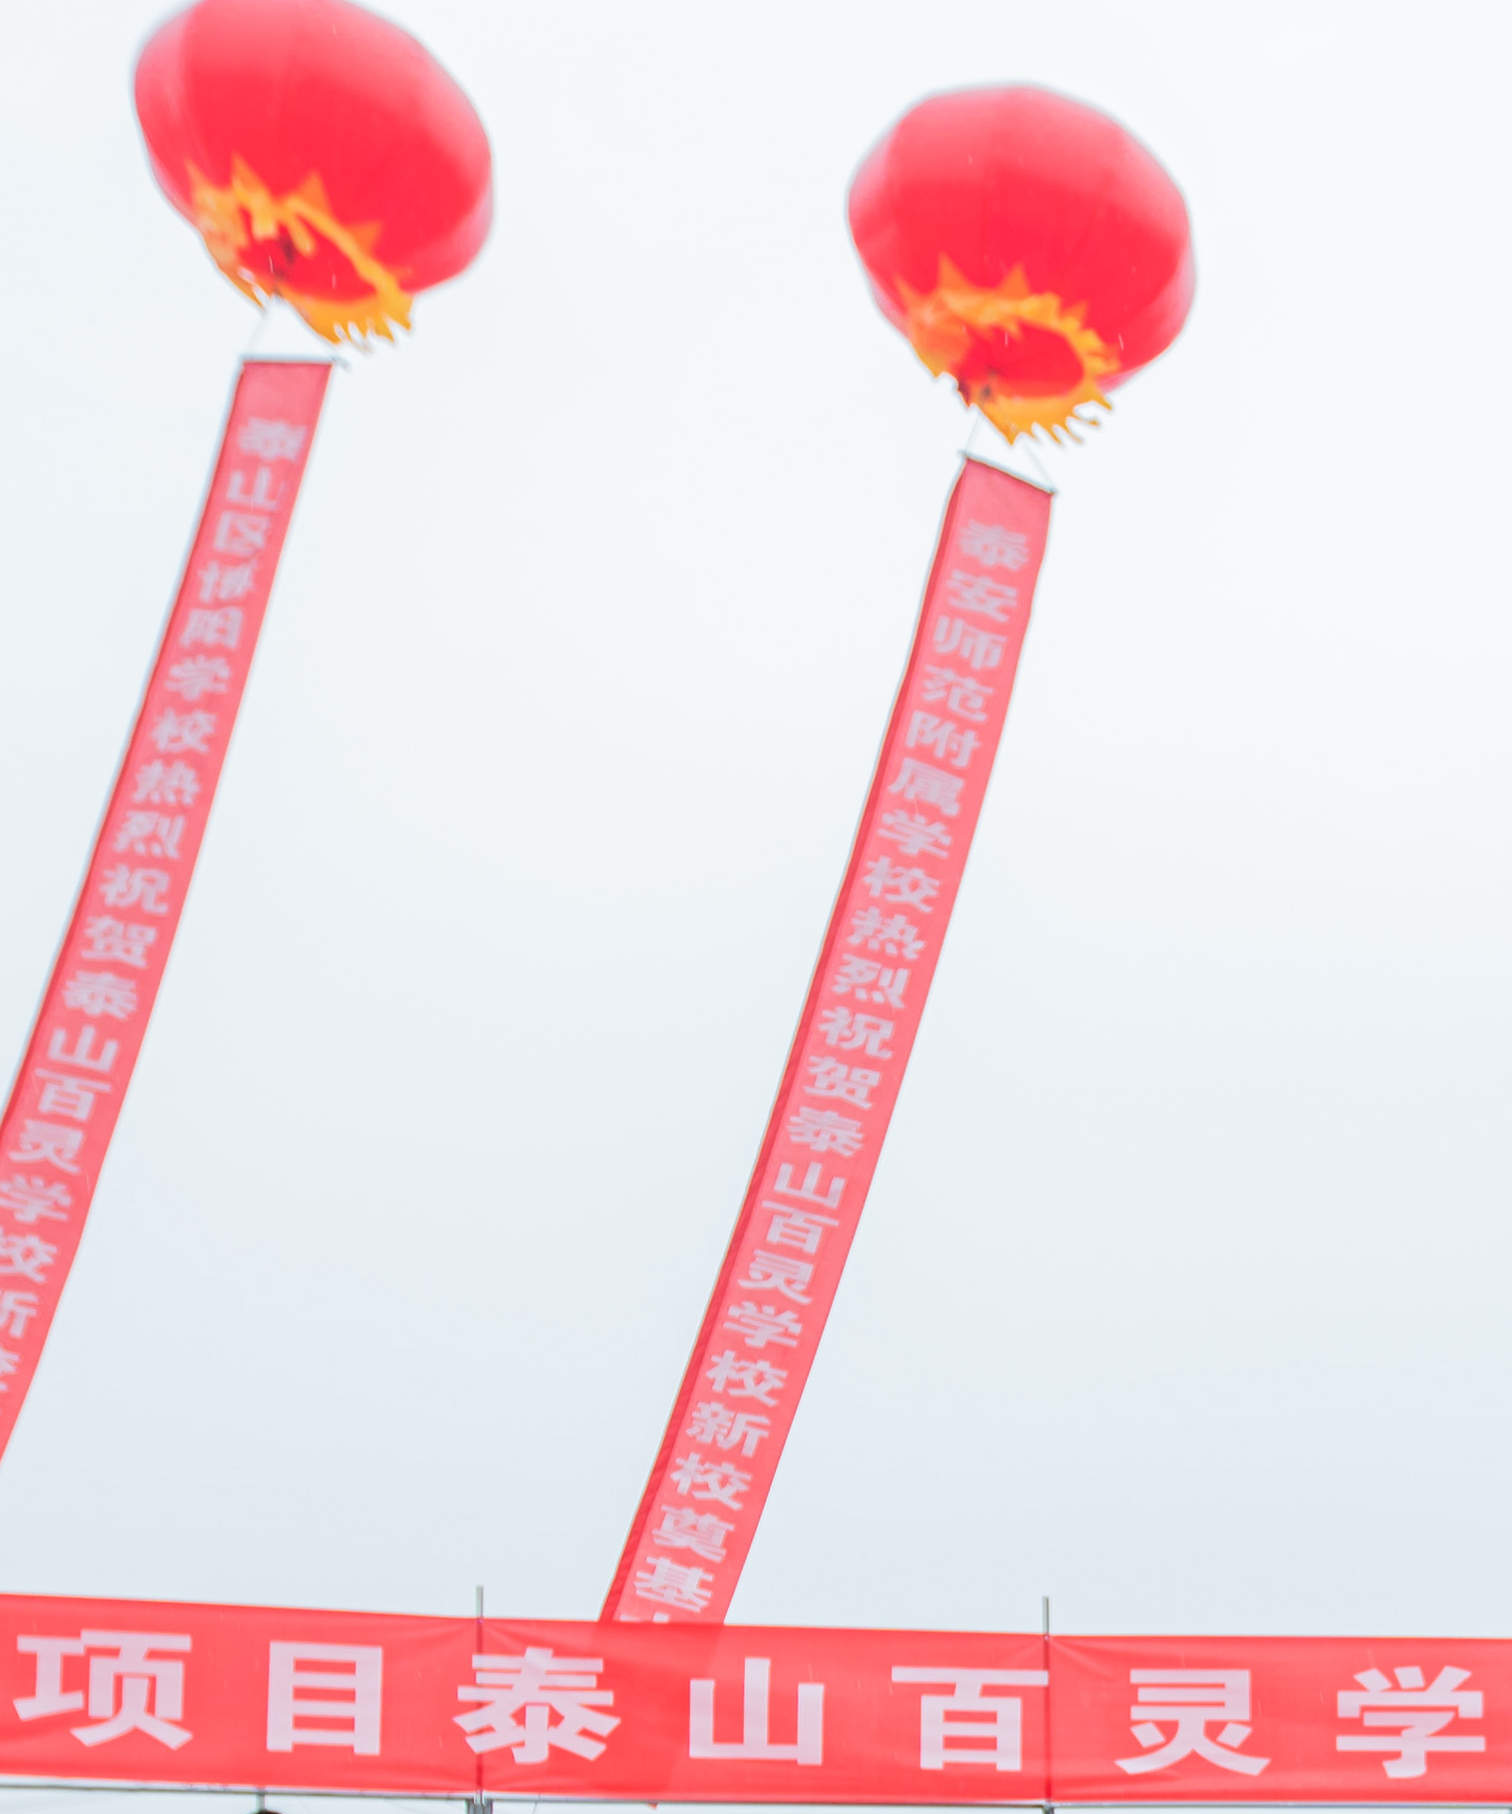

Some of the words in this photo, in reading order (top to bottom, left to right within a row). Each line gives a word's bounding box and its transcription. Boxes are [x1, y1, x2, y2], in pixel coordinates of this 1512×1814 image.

[619, 520, 1029, 1623] 泰安师范附属学校热烈祝贺泰山百灵学校新校奠基
